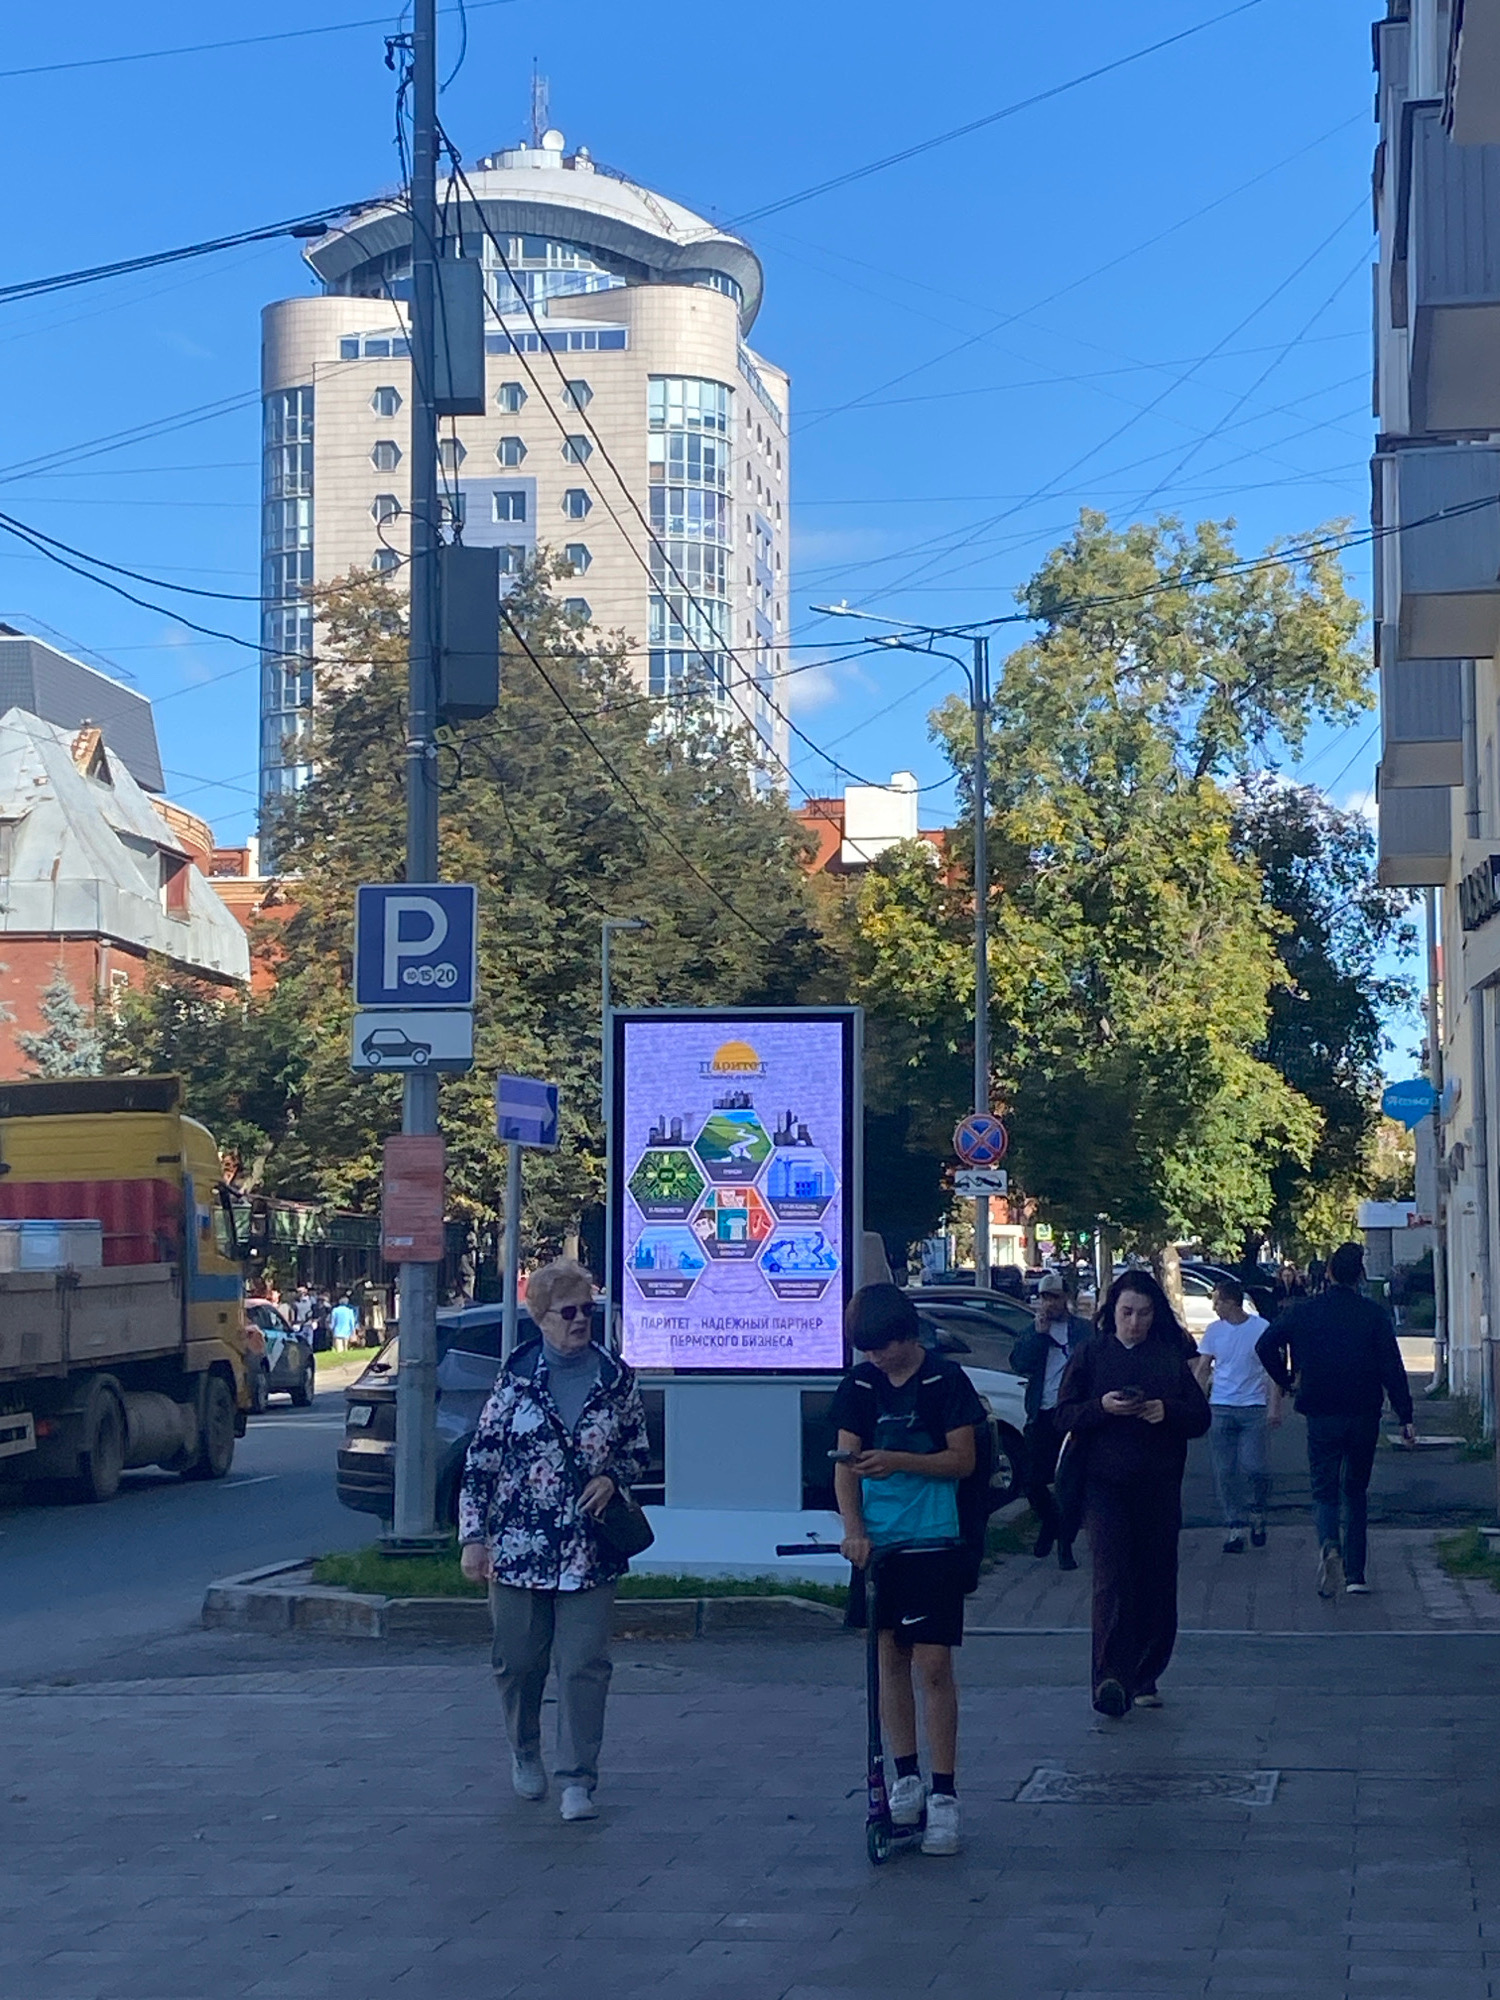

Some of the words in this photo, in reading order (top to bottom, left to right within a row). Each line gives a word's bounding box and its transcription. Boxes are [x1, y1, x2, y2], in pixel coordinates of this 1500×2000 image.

[383, 896, 448, 990] P
[421, 970, 432, 981] 15
[437, 969, 455, 982] 20
[641, 1316, 690, 1329] ПАРИТЕТ
[701, 1315, 769, 1330] НАДЕЖНЫЙ
[773, 1317, 823, 1330] ПАРТНЕР
[670, 1335, 738, 1347] ПЕРМСКОГО
[742, 1335, 793, 1347] БИЗНЕСА
